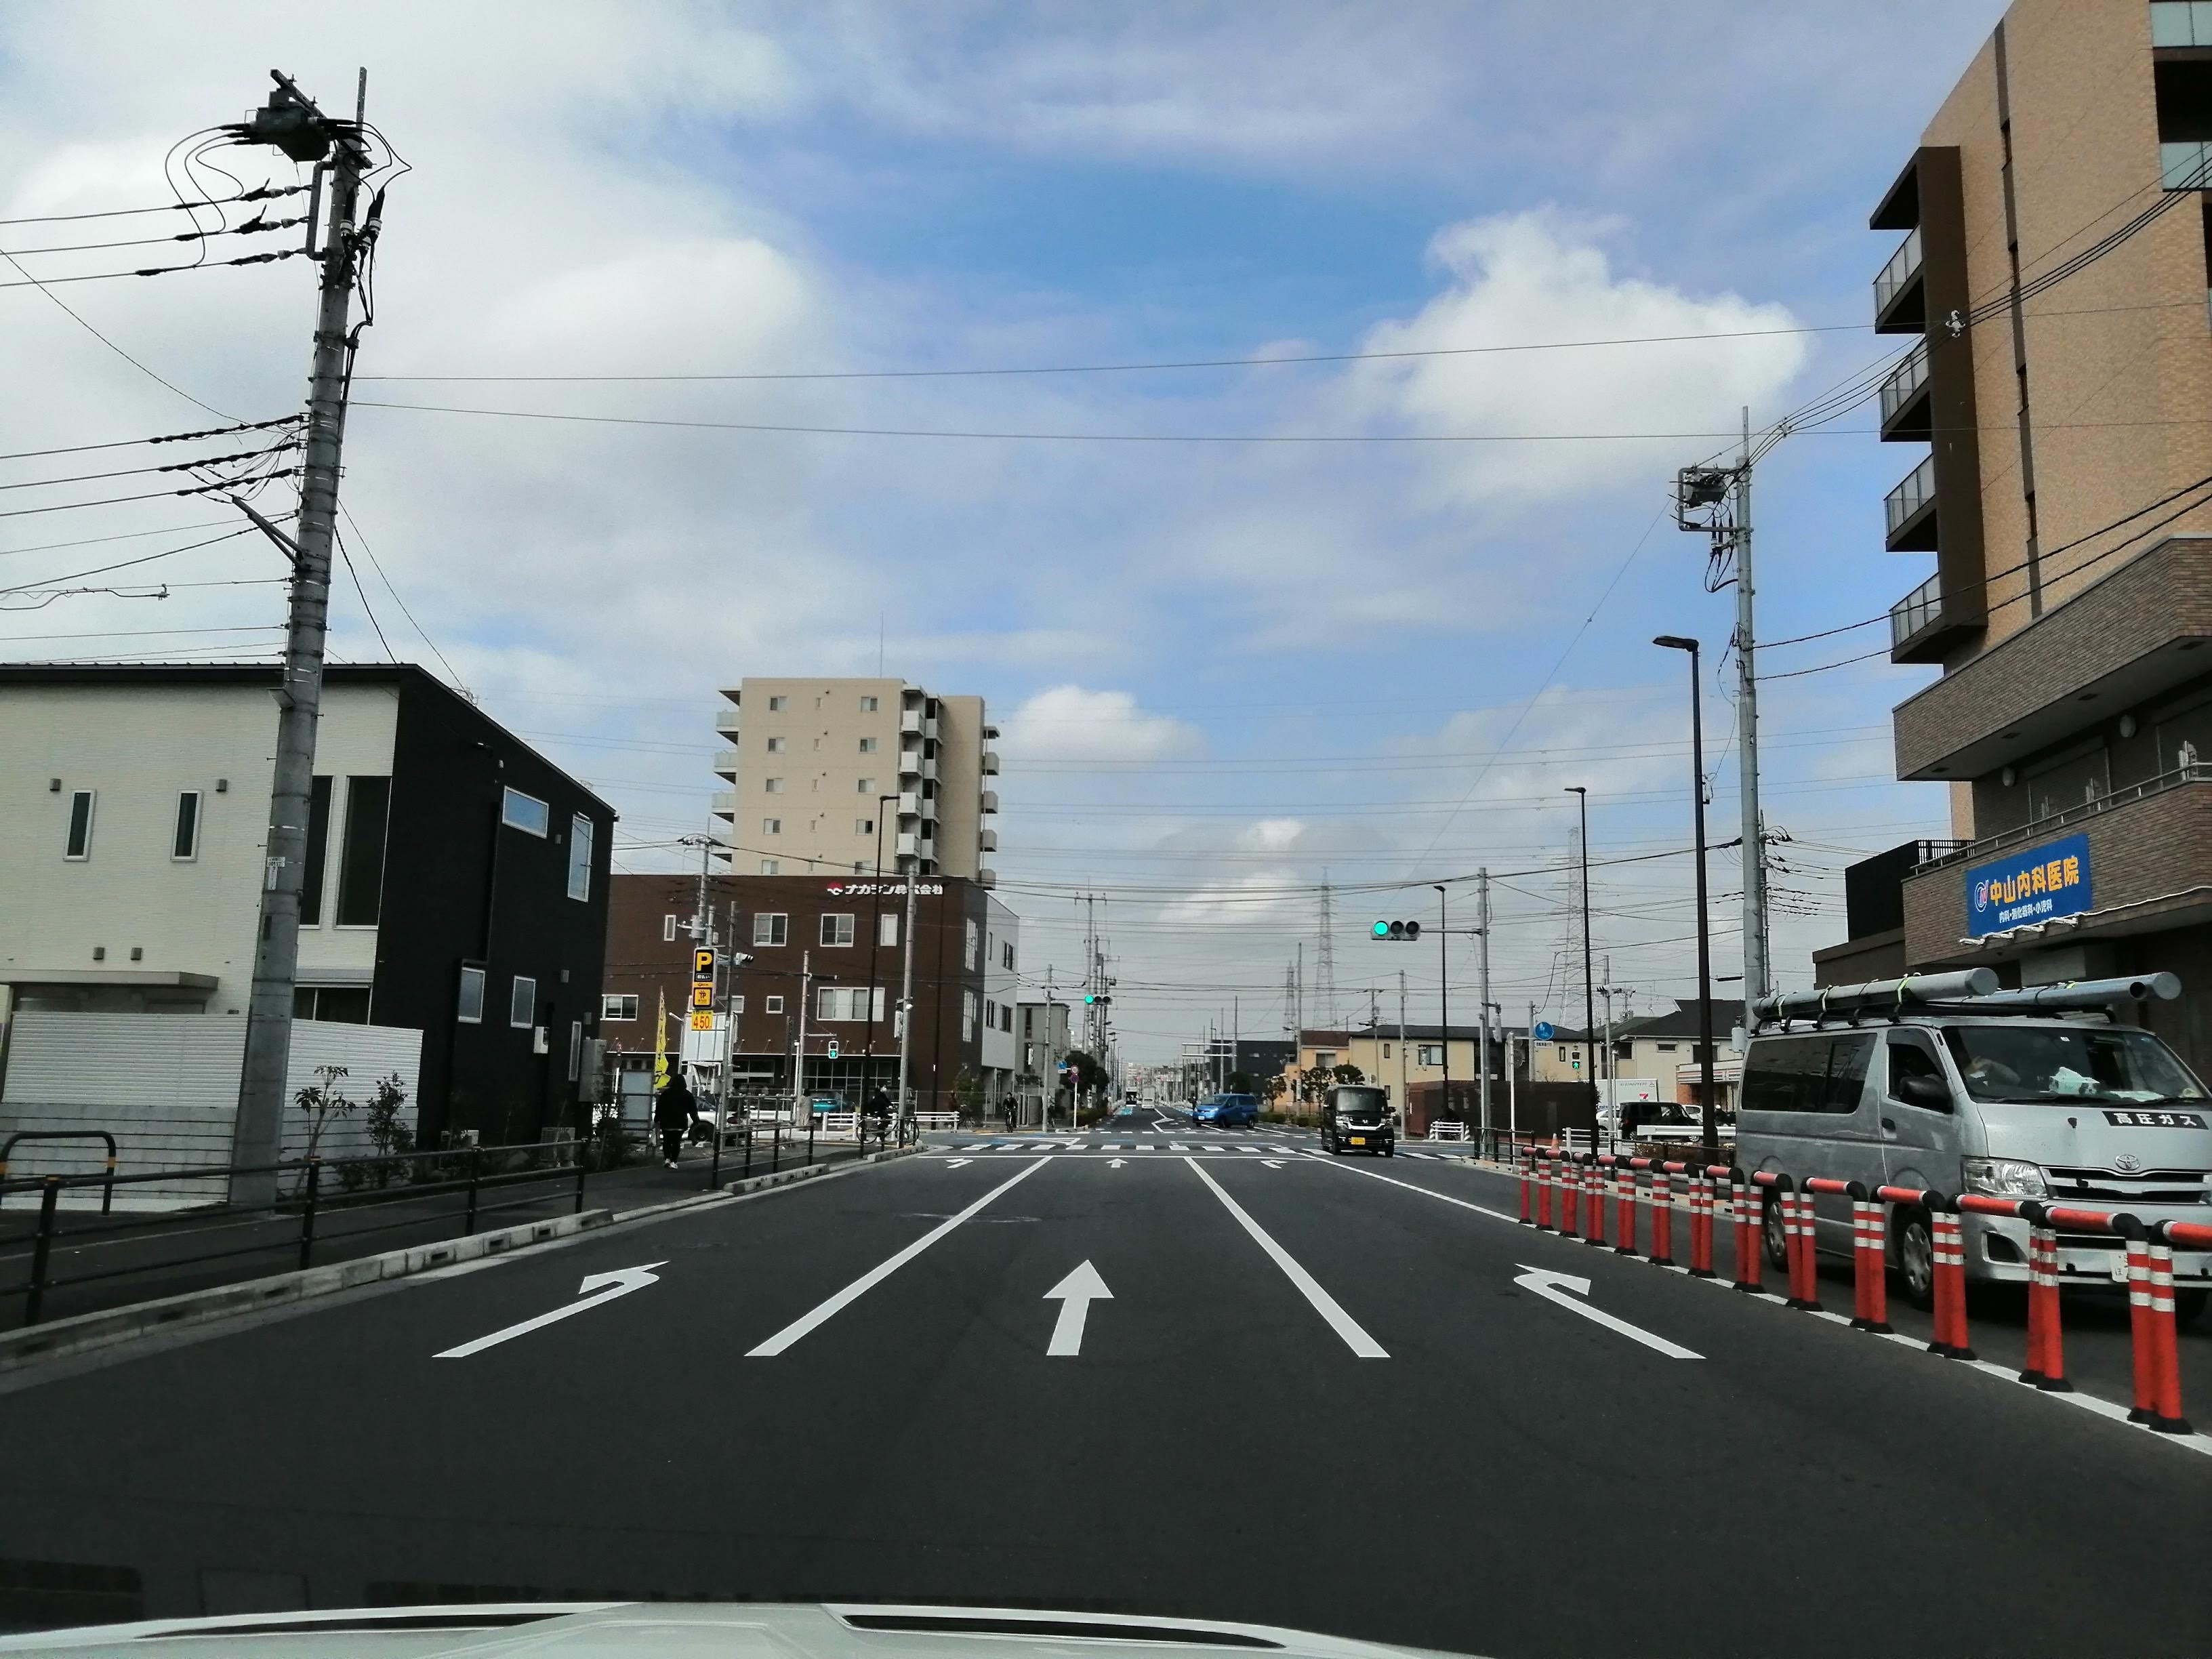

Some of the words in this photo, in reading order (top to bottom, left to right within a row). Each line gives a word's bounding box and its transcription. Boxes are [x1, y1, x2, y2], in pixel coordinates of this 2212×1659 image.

[1990, 855, 2079, 907] 中山内科医院
[696, 952, 713, 971] P
[2113, 1112, 2197, 1126] 高圧ガス
